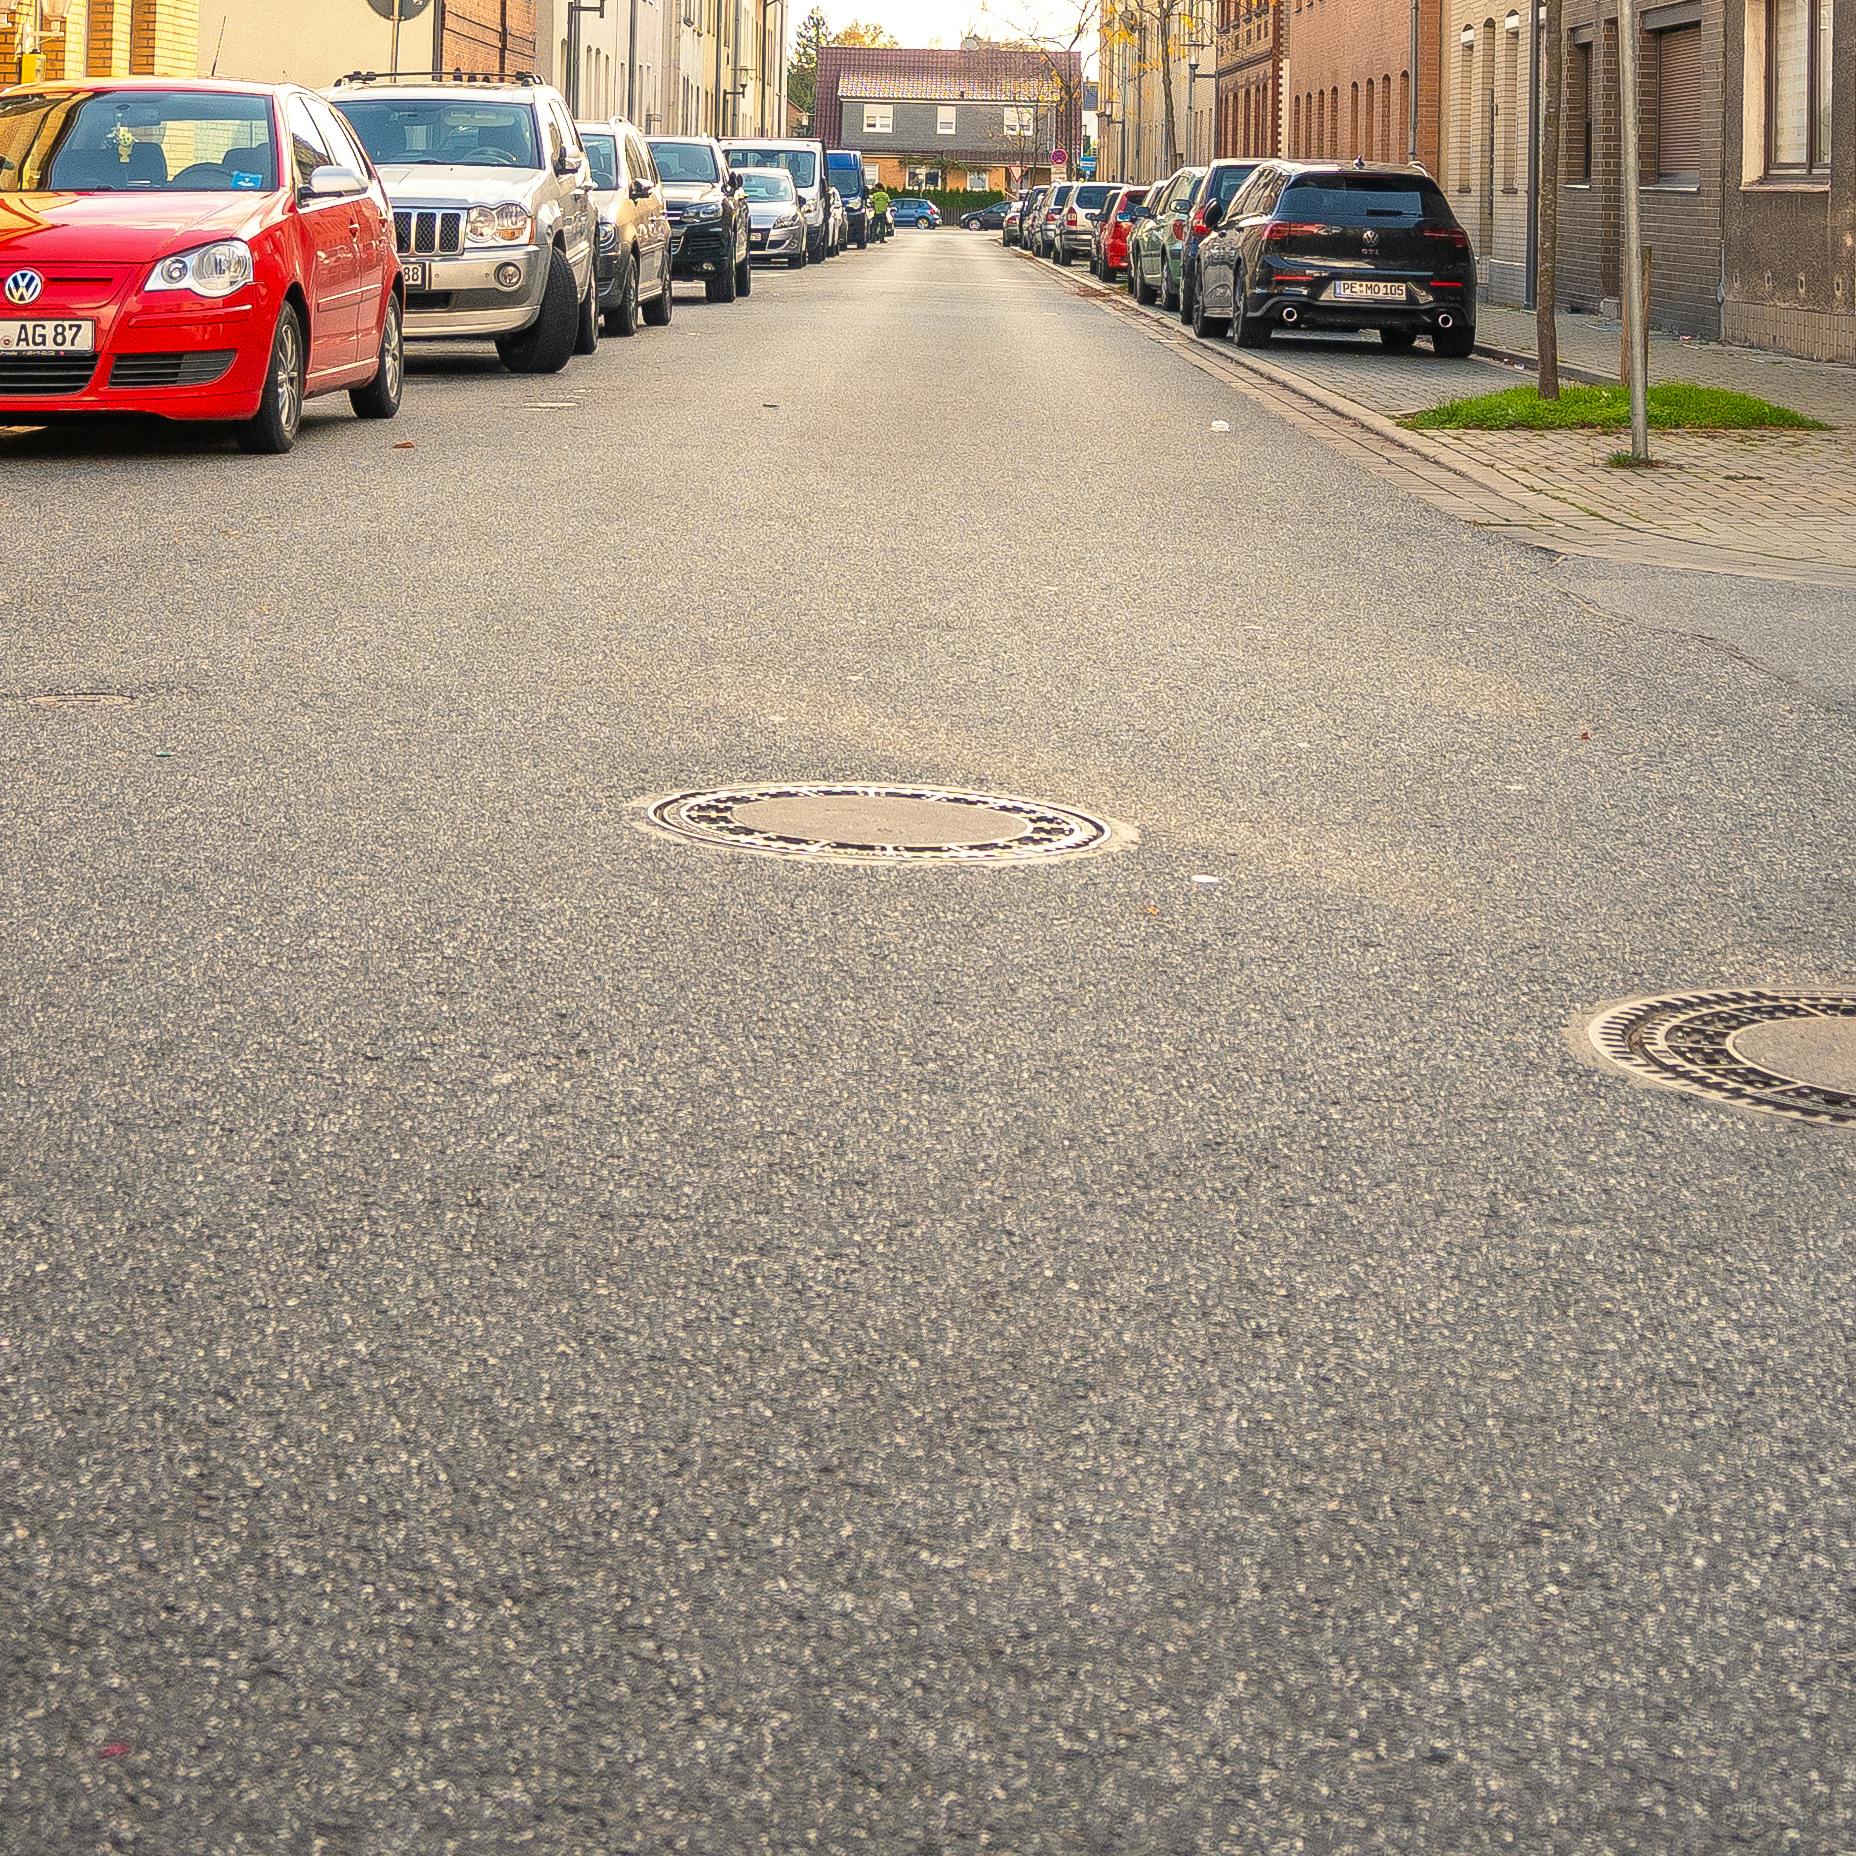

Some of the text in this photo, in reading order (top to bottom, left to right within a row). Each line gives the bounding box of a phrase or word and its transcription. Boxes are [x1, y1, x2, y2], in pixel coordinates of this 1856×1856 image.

[1342, 282, 1357, 294] PE
[1365, 283, 1380, 295] MO
[15, 323, 47, 347] AG
[52, 323, 82, 347] 87
